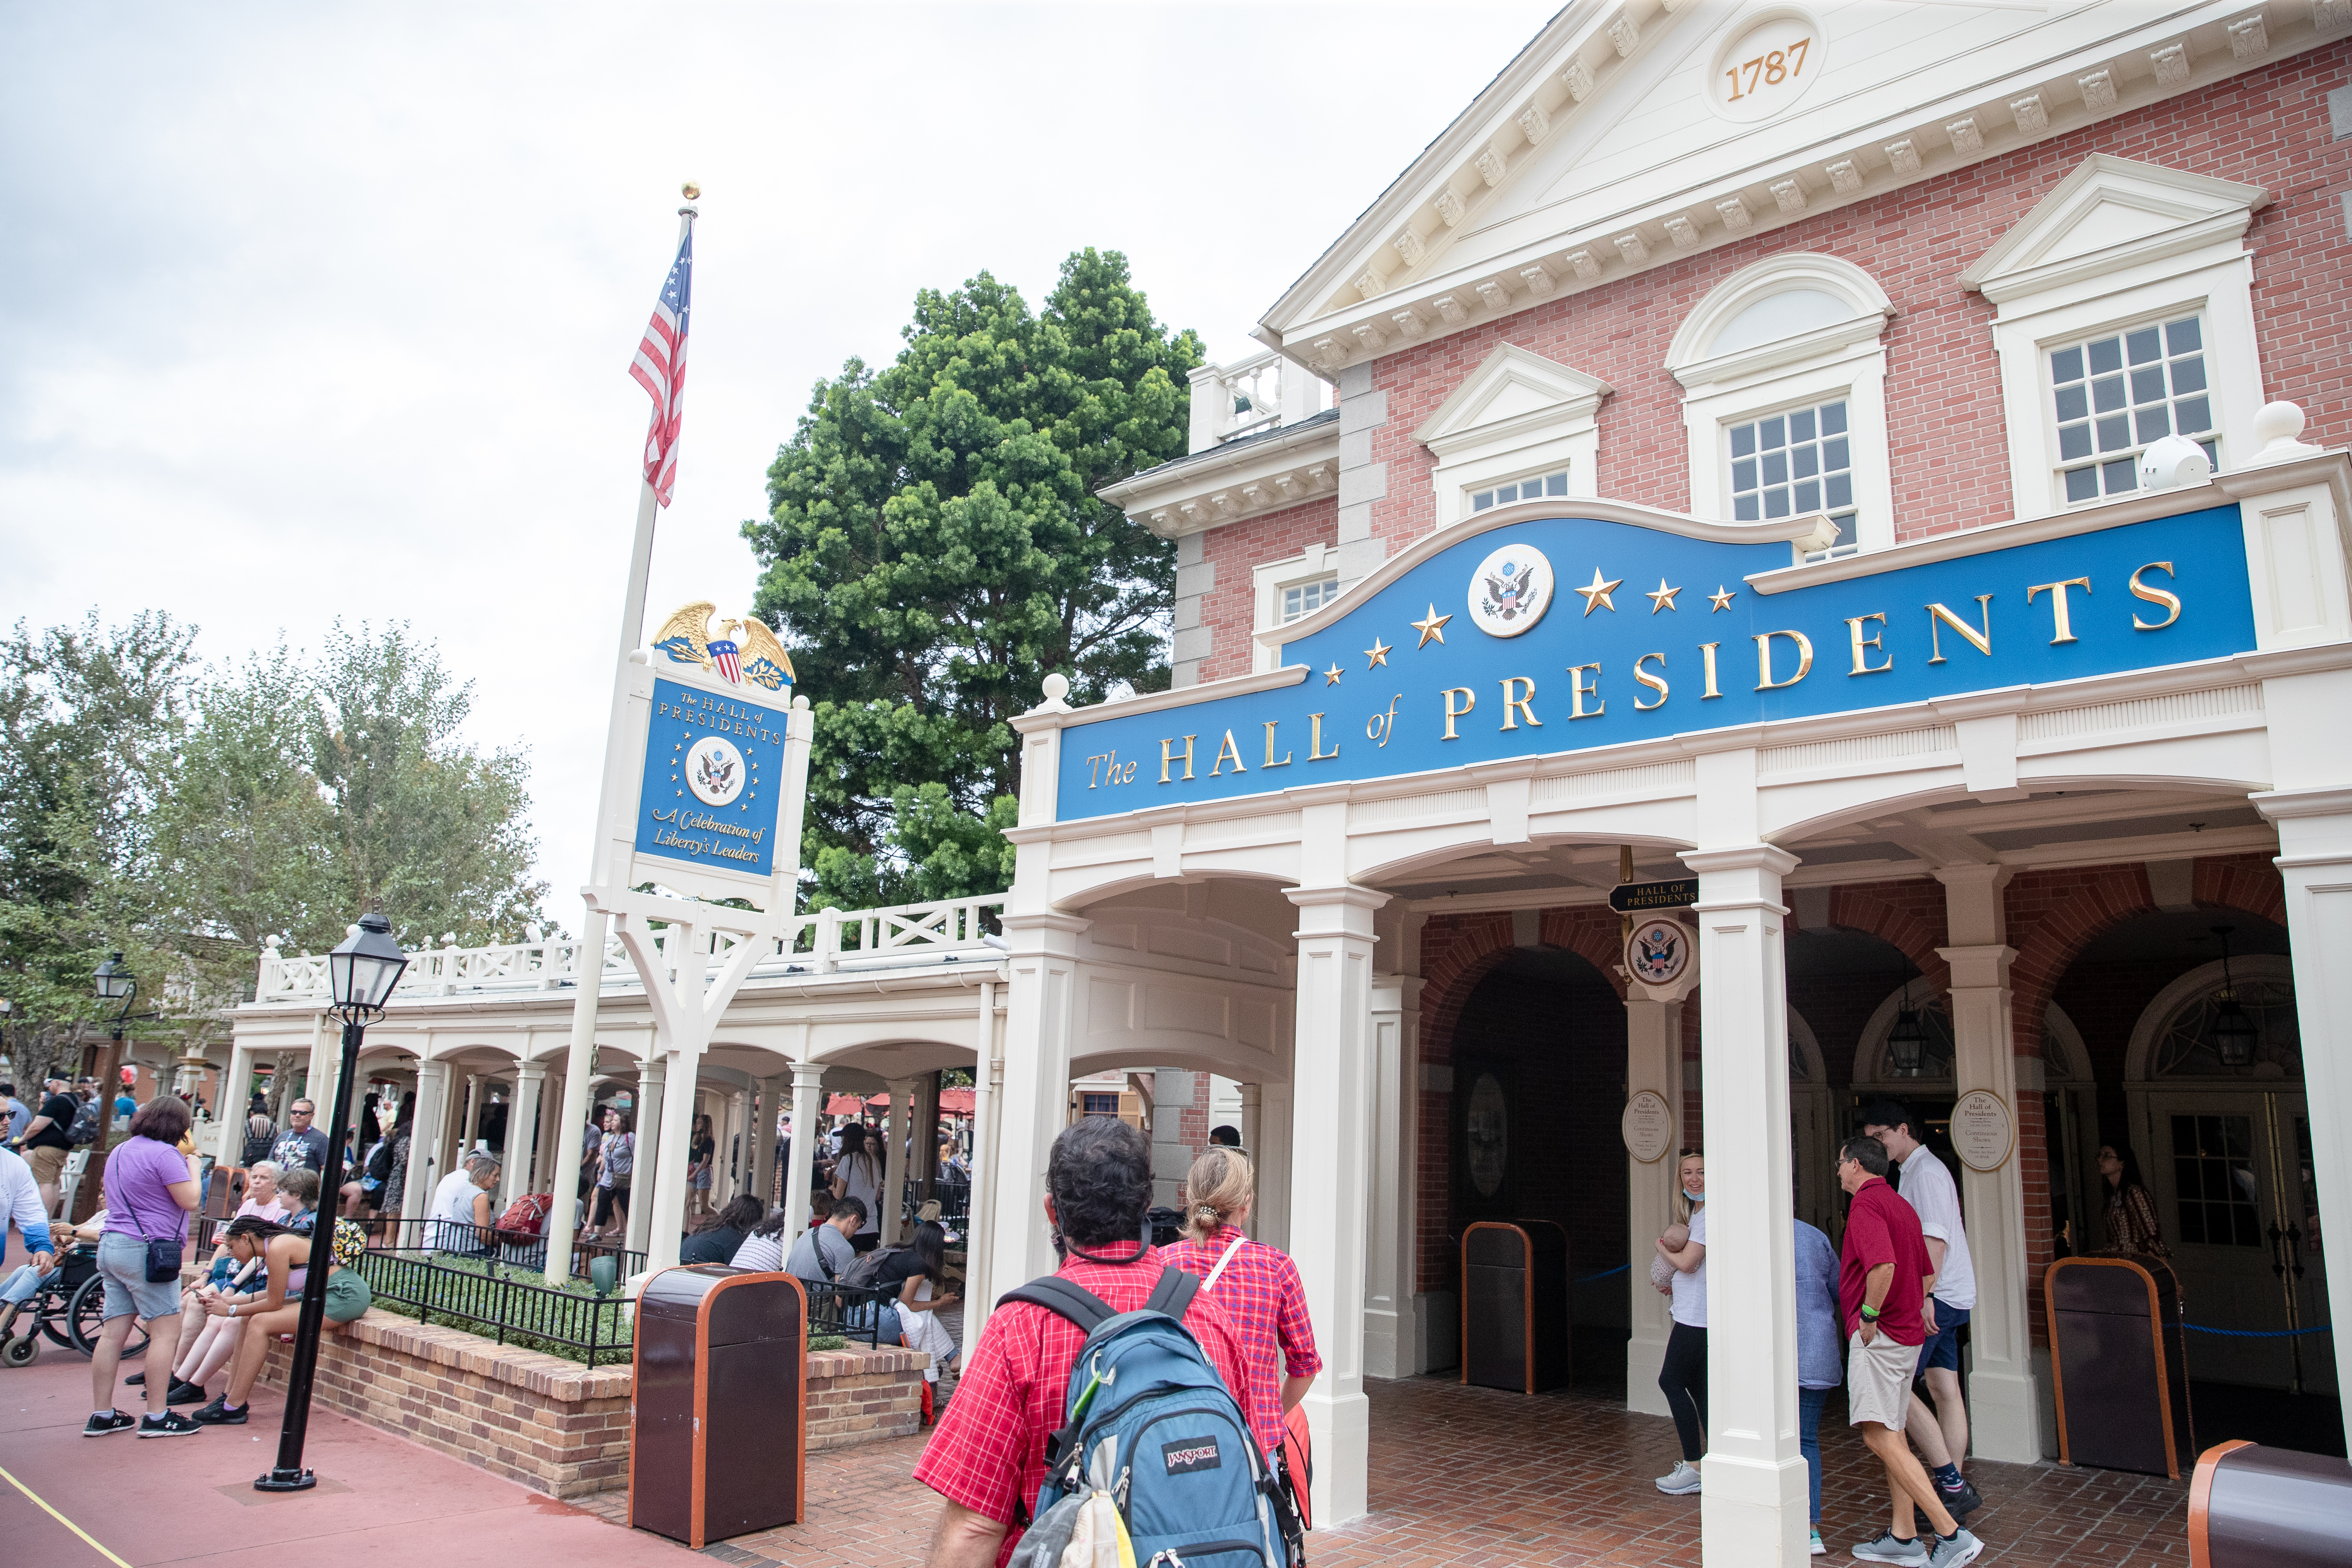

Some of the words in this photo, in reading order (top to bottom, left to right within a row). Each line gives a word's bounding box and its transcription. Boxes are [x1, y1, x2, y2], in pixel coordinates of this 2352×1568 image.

[1726, 37, 1810, 102] 1787
[1087, 749, 1137, 789] The
[1157, 712, 1340, 784] HALL
[1366, 693, 1402, 748] of
[1441, 561, 2181, 741] PRESIDENTS
[659, 703, 780, 744] PRESIDENTS
[681, 692, 697, 705] The
[702, 697, 749, 720] HALL
[754, 713, 764, 723] of
[652, 808, 678, 823] A
[680, 811, 750, 838] Celebration
[752, 827, 766, 845] of
[653, 829, 710, 856] Liberty's
[711, 840, 760, 863] Leaders
[1628, 893, 1695, 906] PRESIDENTS
[1637, 886, 1666, 896] HALL
[1671, 884, 1685, 893] OF
[1167, 1445, 1216, 1467] JANSPORT
